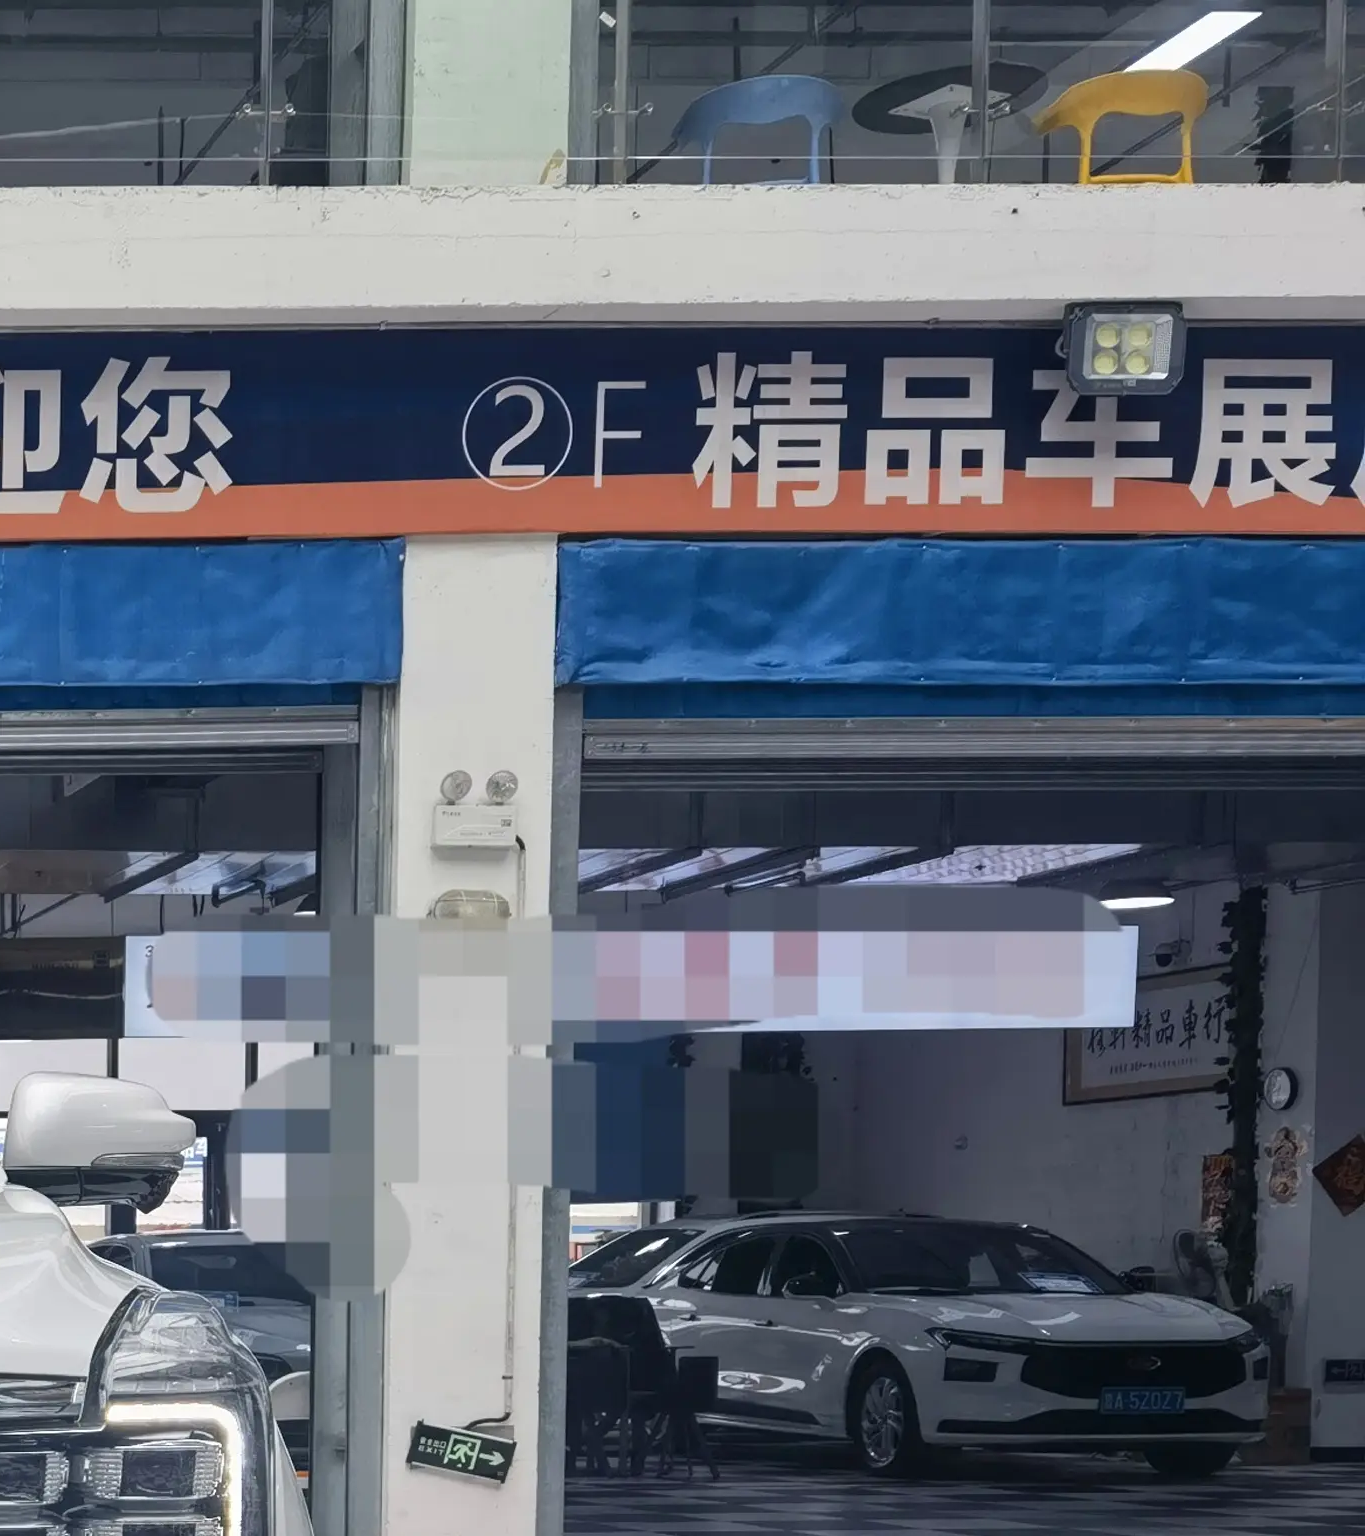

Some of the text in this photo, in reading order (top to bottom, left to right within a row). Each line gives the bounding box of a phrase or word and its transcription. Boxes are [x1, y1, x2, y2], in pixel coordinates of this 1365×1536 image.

[692, 351, 1365, 508] 精品车展
[417, 1445, 445, 1456] EXIT
